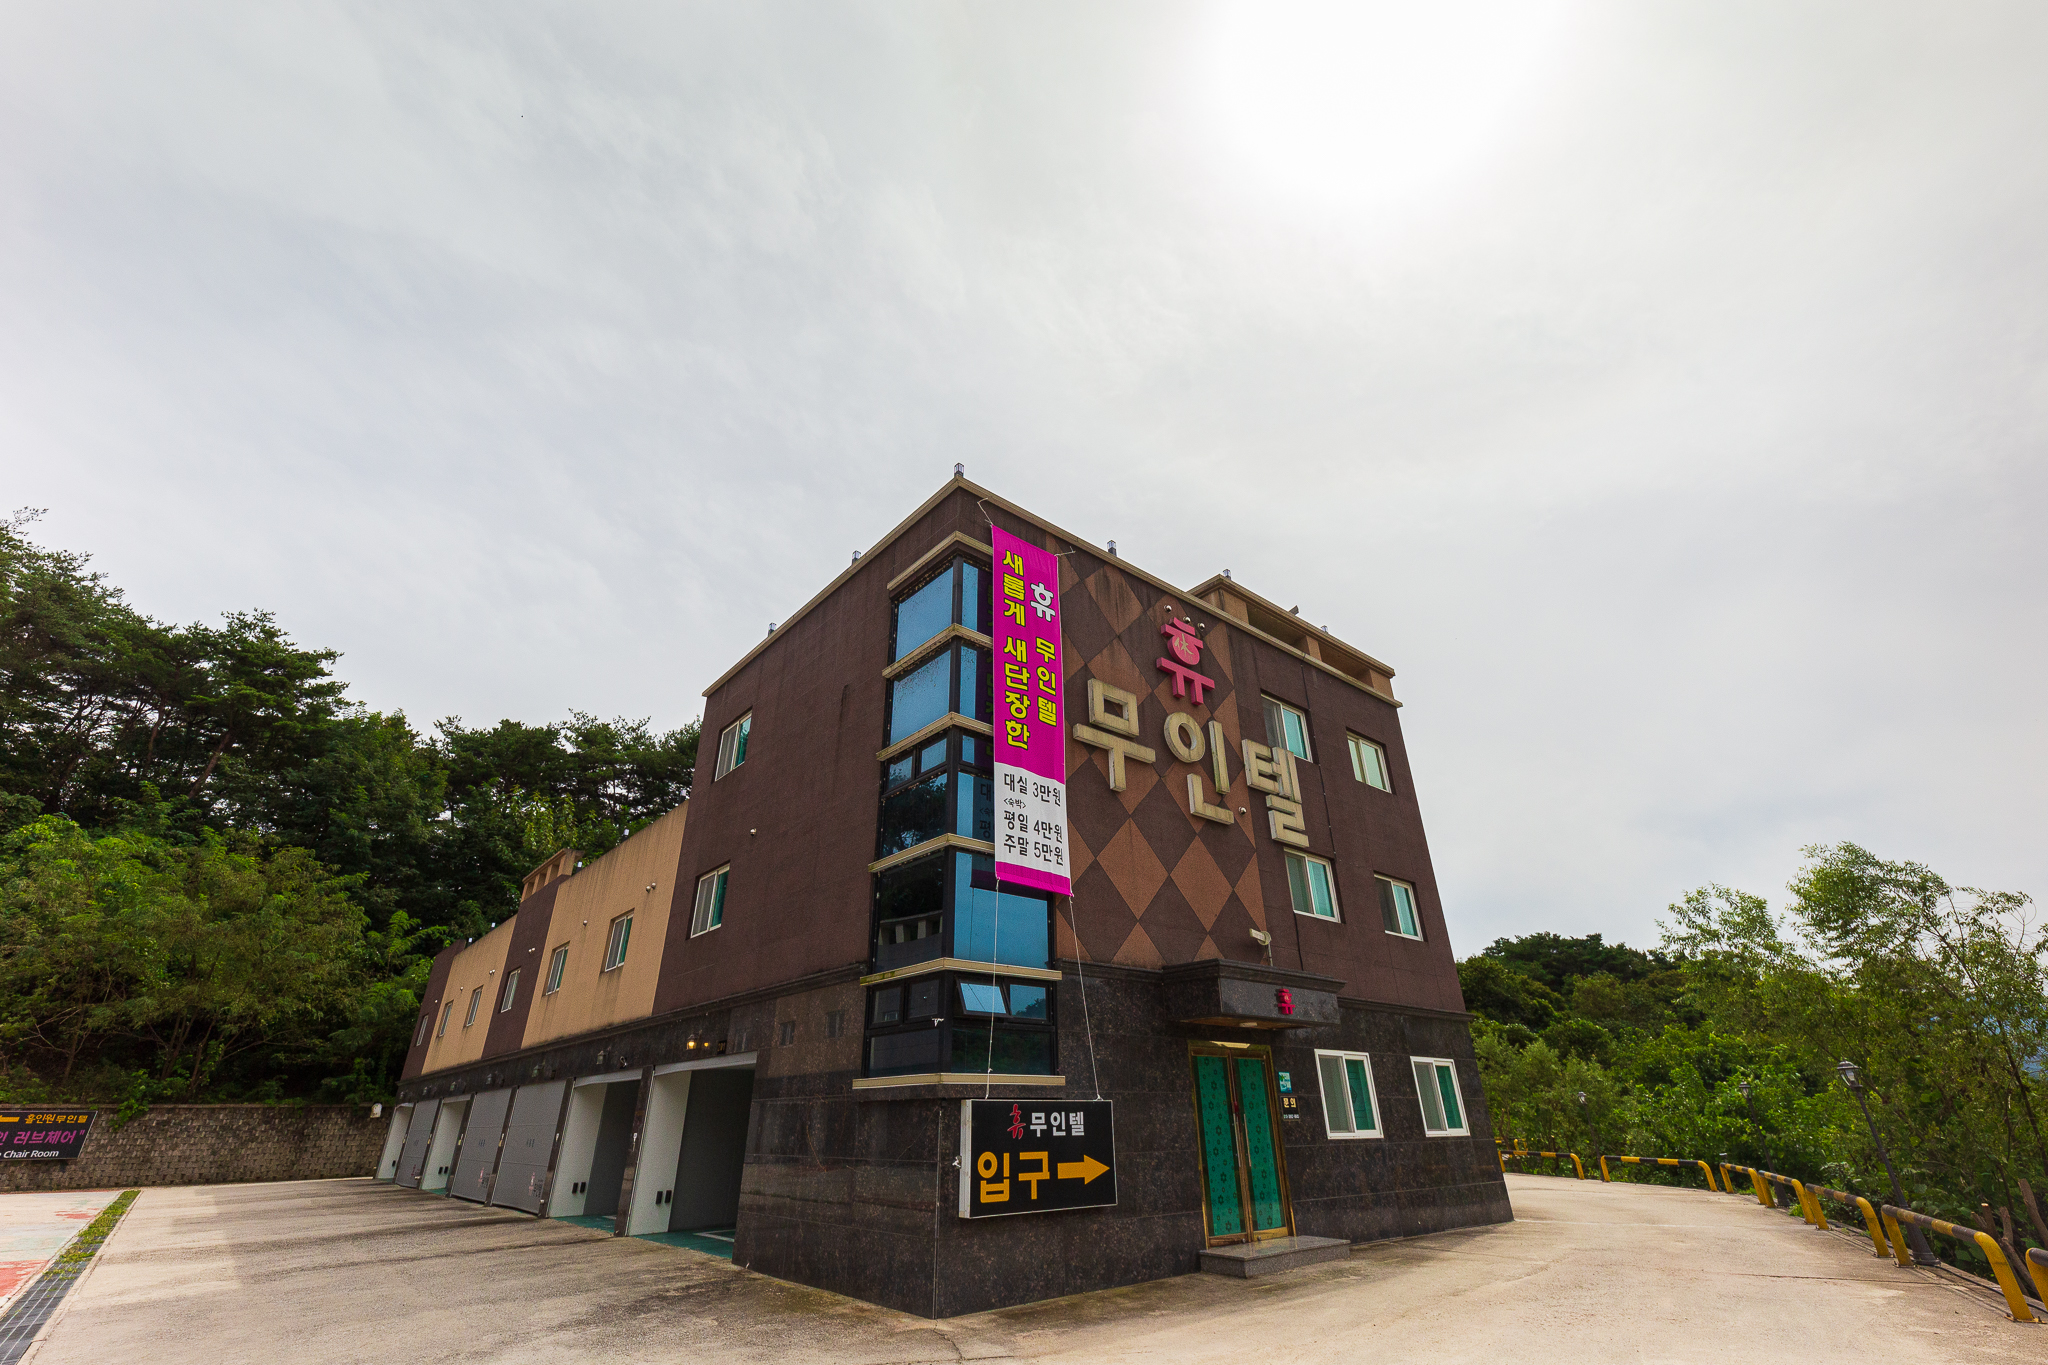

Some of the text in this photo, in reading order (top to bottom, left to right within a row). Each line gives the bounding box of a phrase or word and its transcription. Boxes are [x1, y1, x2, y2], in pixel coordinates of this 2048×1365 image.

[1003, 549, 1031, 750] 새롭게 새단장한
[1030, 581, 1058, 727] 휴 무인텔
[1156, 617, 1215, 706] 휴
[1004, 773, 1061, 807] 대실 3만원
[1004, 810, 1028, 833] 평일
[1033, 820, 1063, 844] 4만원
[1004, 834, 1064, 866] 주말 5만원
[1030, 1111, 1085, 1137] 무인텔
[3, 1149, 31, 1158] Chair
[30, 1150, 60, 1158] Room
[977, 1151, 1050, 1203] 입구
